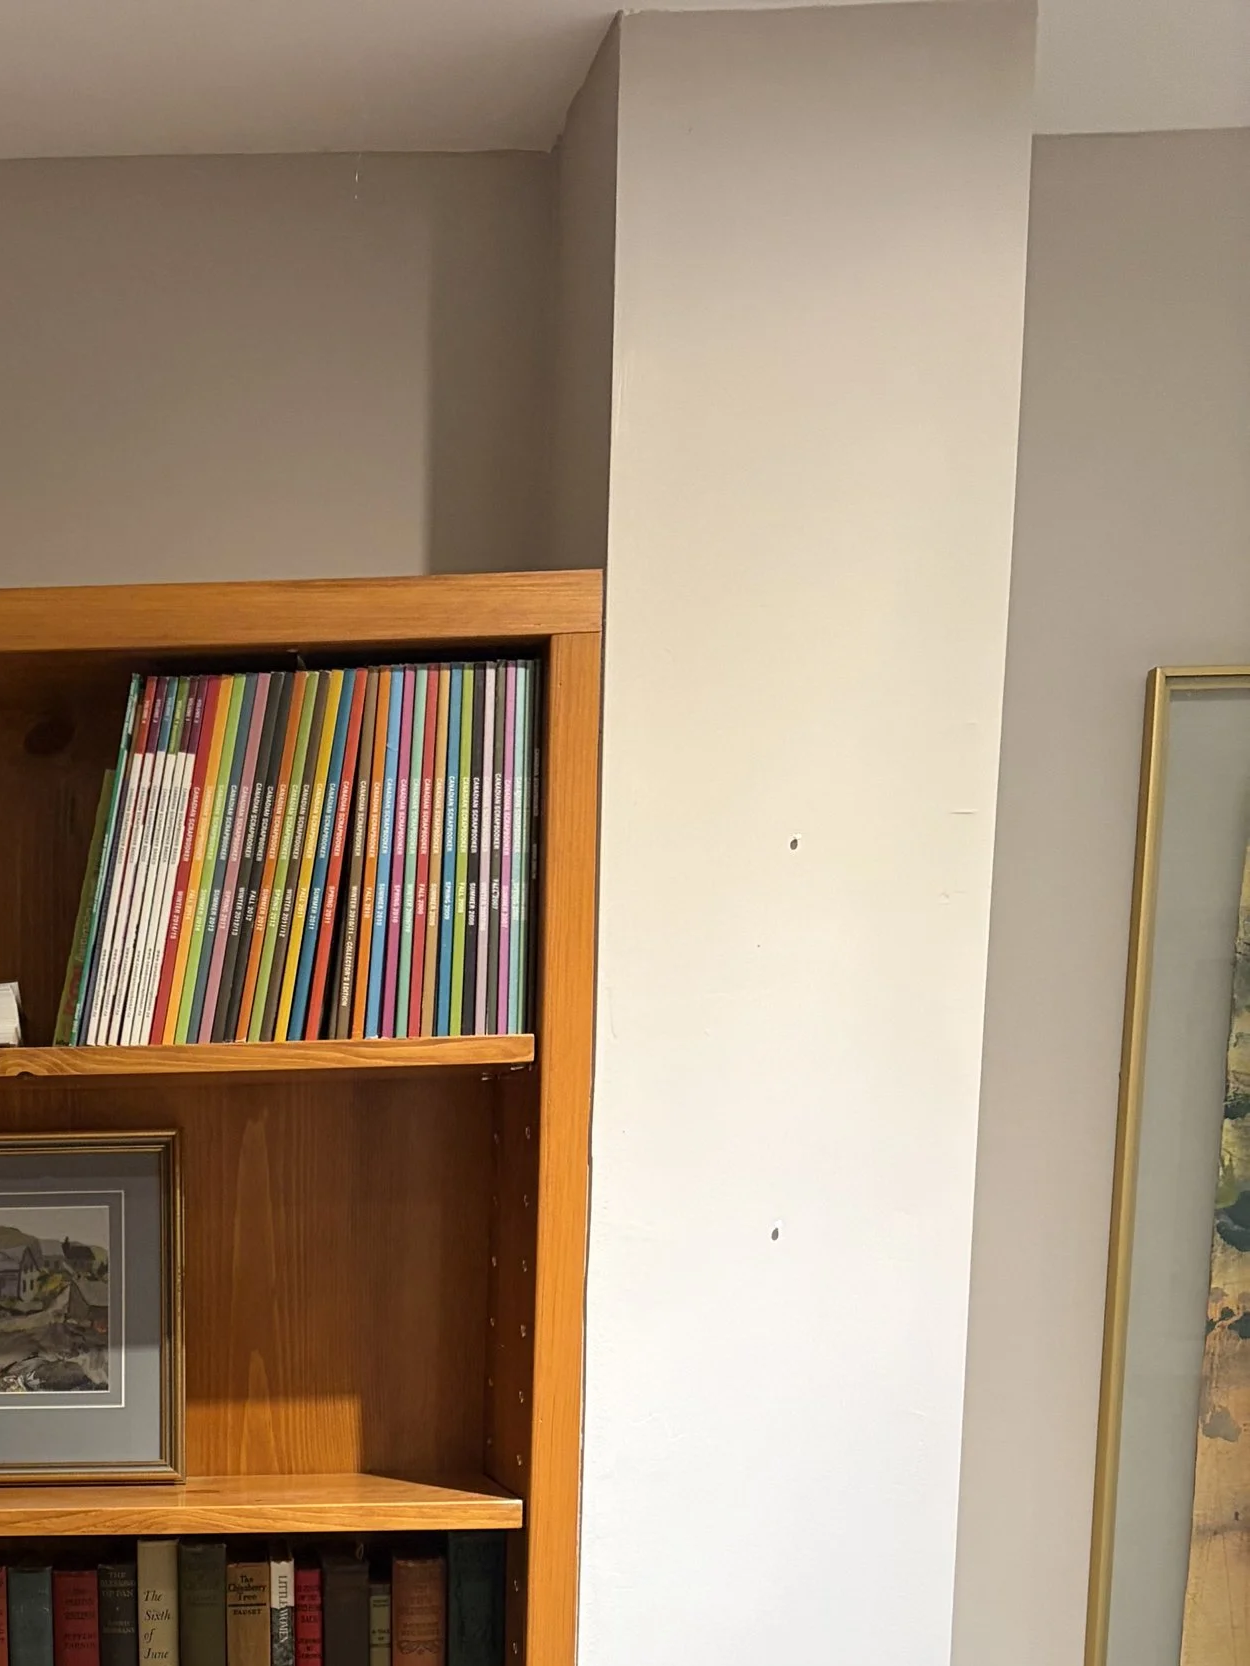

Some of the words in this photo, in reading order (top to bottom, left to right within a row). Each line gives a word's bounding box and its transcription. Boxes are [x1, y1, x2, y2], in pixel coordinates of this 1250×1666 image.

[188, 787, 200, 816] CANADIAN
[226, 785, 237, 814] CANADIAN
[252, 783, 262, 813] CANADIAN
[262, 786, 274, 816] CANADIAN
[276, 784, 286, 814] CANADIAN
[300, 785, 310, 814] CANADIAN
[326, 783, 336, 813] CANADIAN
[340, 781, 350, 811] CANADIAN
[358, 781, 367, 811] CANADIAN
[372, 783, 380, 812] CANADIAN
[385, 778, 393, 809] CANADIAN
[399, 780, 407, 810] CANADIAN
[472, 777, 480, 808] CANADIAN
[183, 818, 195, 861] SCRAPBOOKER
[220, 816, 232, 860] SCRAPBOOKER
[245, 815, 257, 857] SCRAPBOOKER
[256, 818, 268, 861] SCRAPBOOKER
[270, 816, 281, 859] SCRAPBOOKER
[292, 816, 304, 860] SCRAPBOOKER
[320, 814, 331, 858] SCRAPBOOKER
[334, 813, 346, 856] SCRAPBOOKER
[354, 812, 362, 856] SCRAPBOOKER
[369, 814, 377, 857] SCRAPBOOKER
[382, 810, 390, 854] SCRAPBOOKER
[396, 812, 404, 855] SCRAPBOOKER
[240, 1575, 254, 1583] The
[278, 1575, 288, 1607] LITTLE
[143, 1590, 162, 1601] The
[238, 1593, 257, 1601] Tree
[144, 1609, 170, 1621] Sixth
[278, 1608, 289, 1643] WOMEN
[143, 1628, 156, 1644] of
[143, 1647, 168, 1659] June
